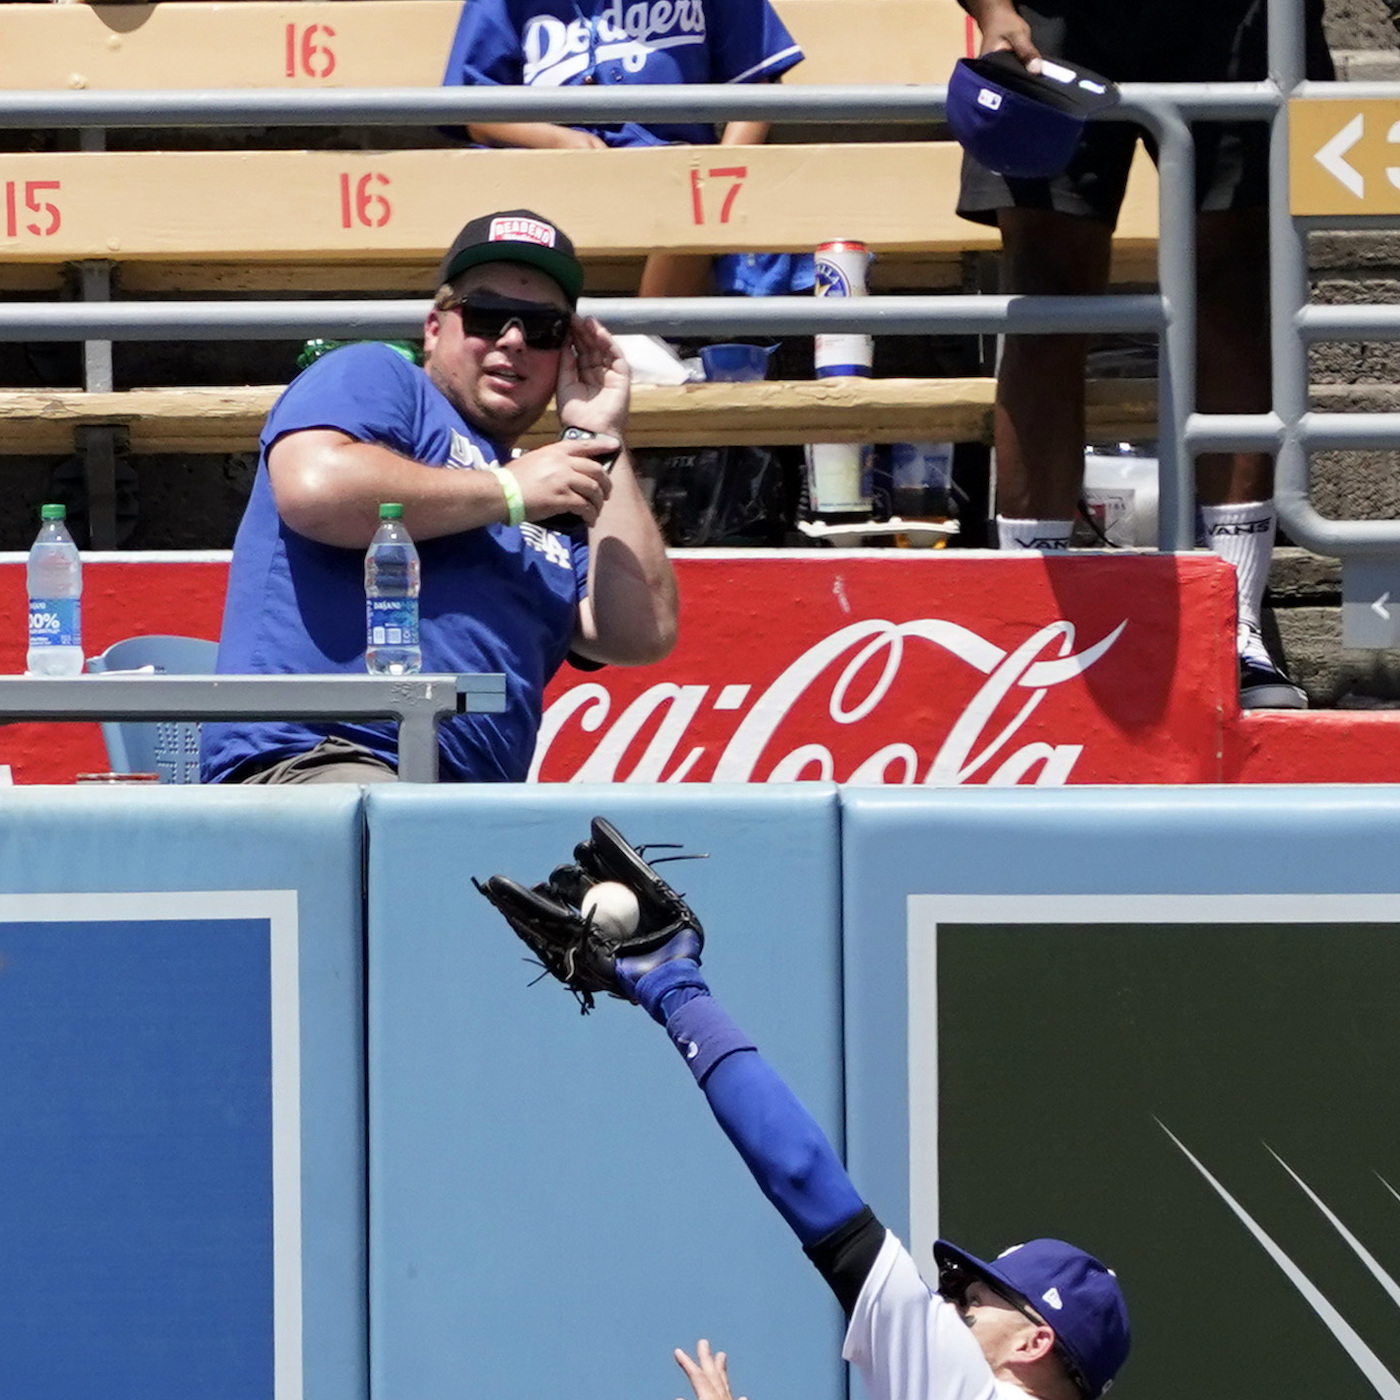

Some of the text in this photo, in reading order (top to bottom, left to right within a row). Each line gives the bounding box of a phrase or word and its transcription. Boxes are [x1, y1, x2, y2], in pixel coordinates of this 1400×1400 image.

[287, 24, 336, 78] 16
[6, 180, 61, 237] 15
[341, 172, 392, 229] 16
[690, 166, 748, 225] 17
[1015, 537, 1070, 550] VAN
[29, 613, 60, 629] 00%
